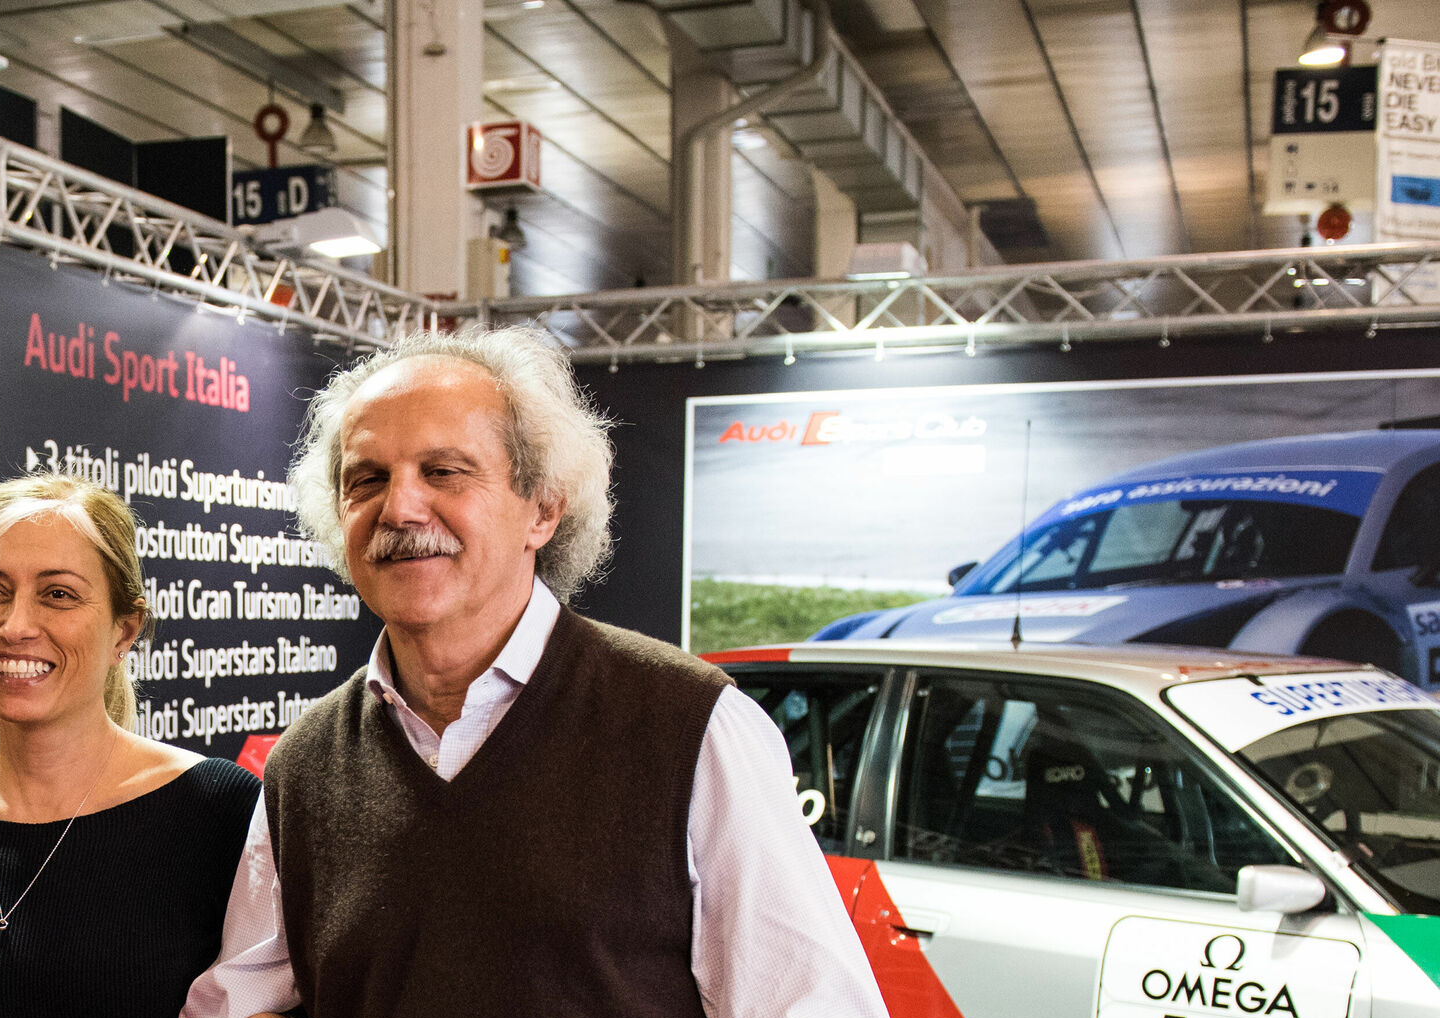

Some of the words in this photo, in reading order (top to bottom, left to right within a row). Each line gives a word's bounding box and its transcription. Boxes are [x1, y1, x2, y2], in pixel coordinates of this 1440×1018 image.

[1300, 80, 1340, 123] 15
[1385, 92, 1417, 111] DIE
[1386, 111, 1437, 132] EASY
[233, 180, 262, 219] 15
[288, 176, 309, 215] D
[24, 313, 95, 379] Audi
[104, 331, 180, 402] Sport
[185, 351, 250, 412] Italia
[719, 420, 797, 444] Audi
[44, 439, 59, 477] 3
[65, 444, 119, 491] titoli
[124, 453, 177, 505] piloti
[136, 520, 227, 563] ostruttori
[230, 523, 331, 574] Superturism
[144, 577, 184, 620] iloti
[187, 579, 231, 620] Gran
[233, 580, 301, 620] Turismo
[302, 583, 359, 621] Italiano
[181, 638, 275, 688] Superstars
[277, 635, 337, 674] Italiano
[181, 696, 275, 746] Superstars
[1142, 969, 1299, 1018] OMEGA
